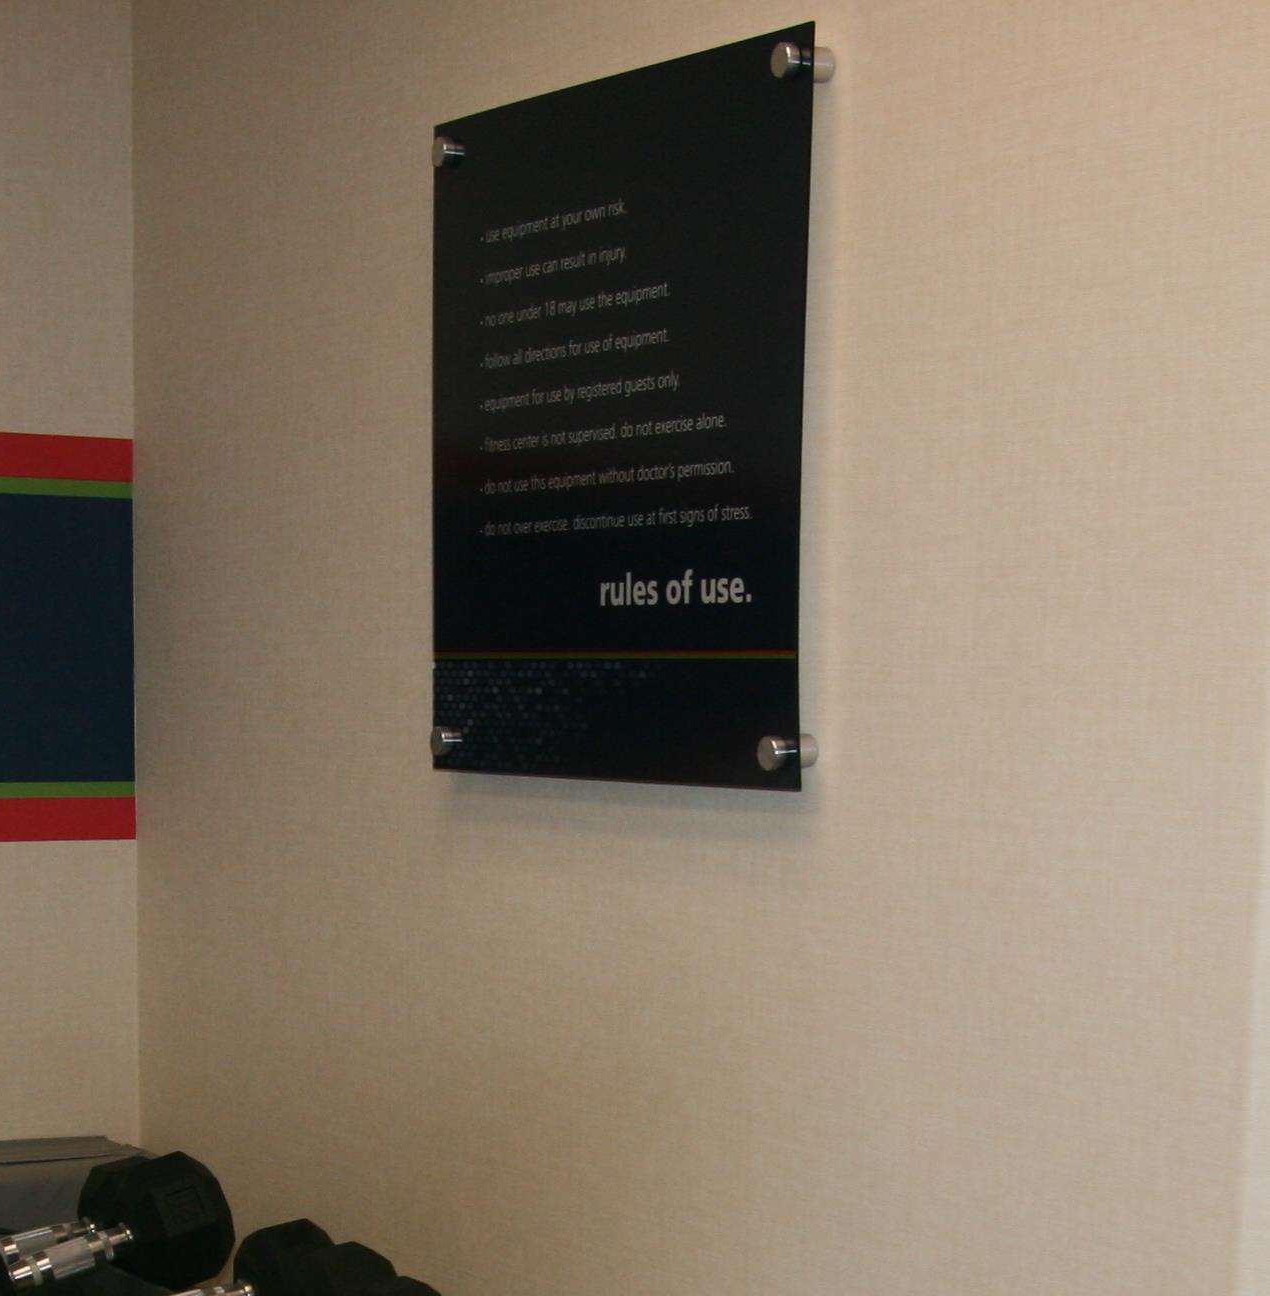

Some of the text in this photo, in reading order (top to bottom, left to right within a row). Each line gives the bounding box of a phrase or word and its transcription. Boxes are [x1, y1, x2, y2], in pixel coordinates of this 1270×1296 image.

[549, 213, 560, 229] at
[561, 210, 583, 231] your
[584, 206, 606, 222] own
[525, 263, 541, 278] use
[542, 260, 559, 274] can
[560, 251, 586, 271] result
[485, 315, 496, 327] no
[516, 305, 542, 322] under
[545, 299, 556, 317] 18
[557, 299, 578, 317] may
[579, 297, 595, 311] use
[597, 291, 613, 308] the
[512, 348, 523, 365] all
[568, 339, 581, 357] for
[584, 340, 601, 354] use
[602, 333, 614, 352] of
[532, 388, 545, 406] for
[546, 390, 561, 403] use
[563, 385, 576, 405] by
[577, 376, 622, 402] registered
[624, 376, 656, 398] guests
[512, 435, 540, 450] center
[541, 431, 549, 448] is
[551, 431, 566, 446] not
[620, 420, 634, 438] do
[635, 420, 653, 436] not
[655, 418, 695, 434] exercise
[696, 412, 726, 430] alone.
[484, 458, 734, 495] do not use this equipment without doctor's permission.
[484, 521, 496, 536] do
[498, 521, 513, 535] not
[627, 512, 645, 527] use
[647, 511, 657, 526] at
[658, 506, 678, 525] first
[679, 506, 706, 528] signs
[707, 503, 720, 522] of
[721, 504, 753, 521] stress.
[599, 569, 752, 606] rules of use.
